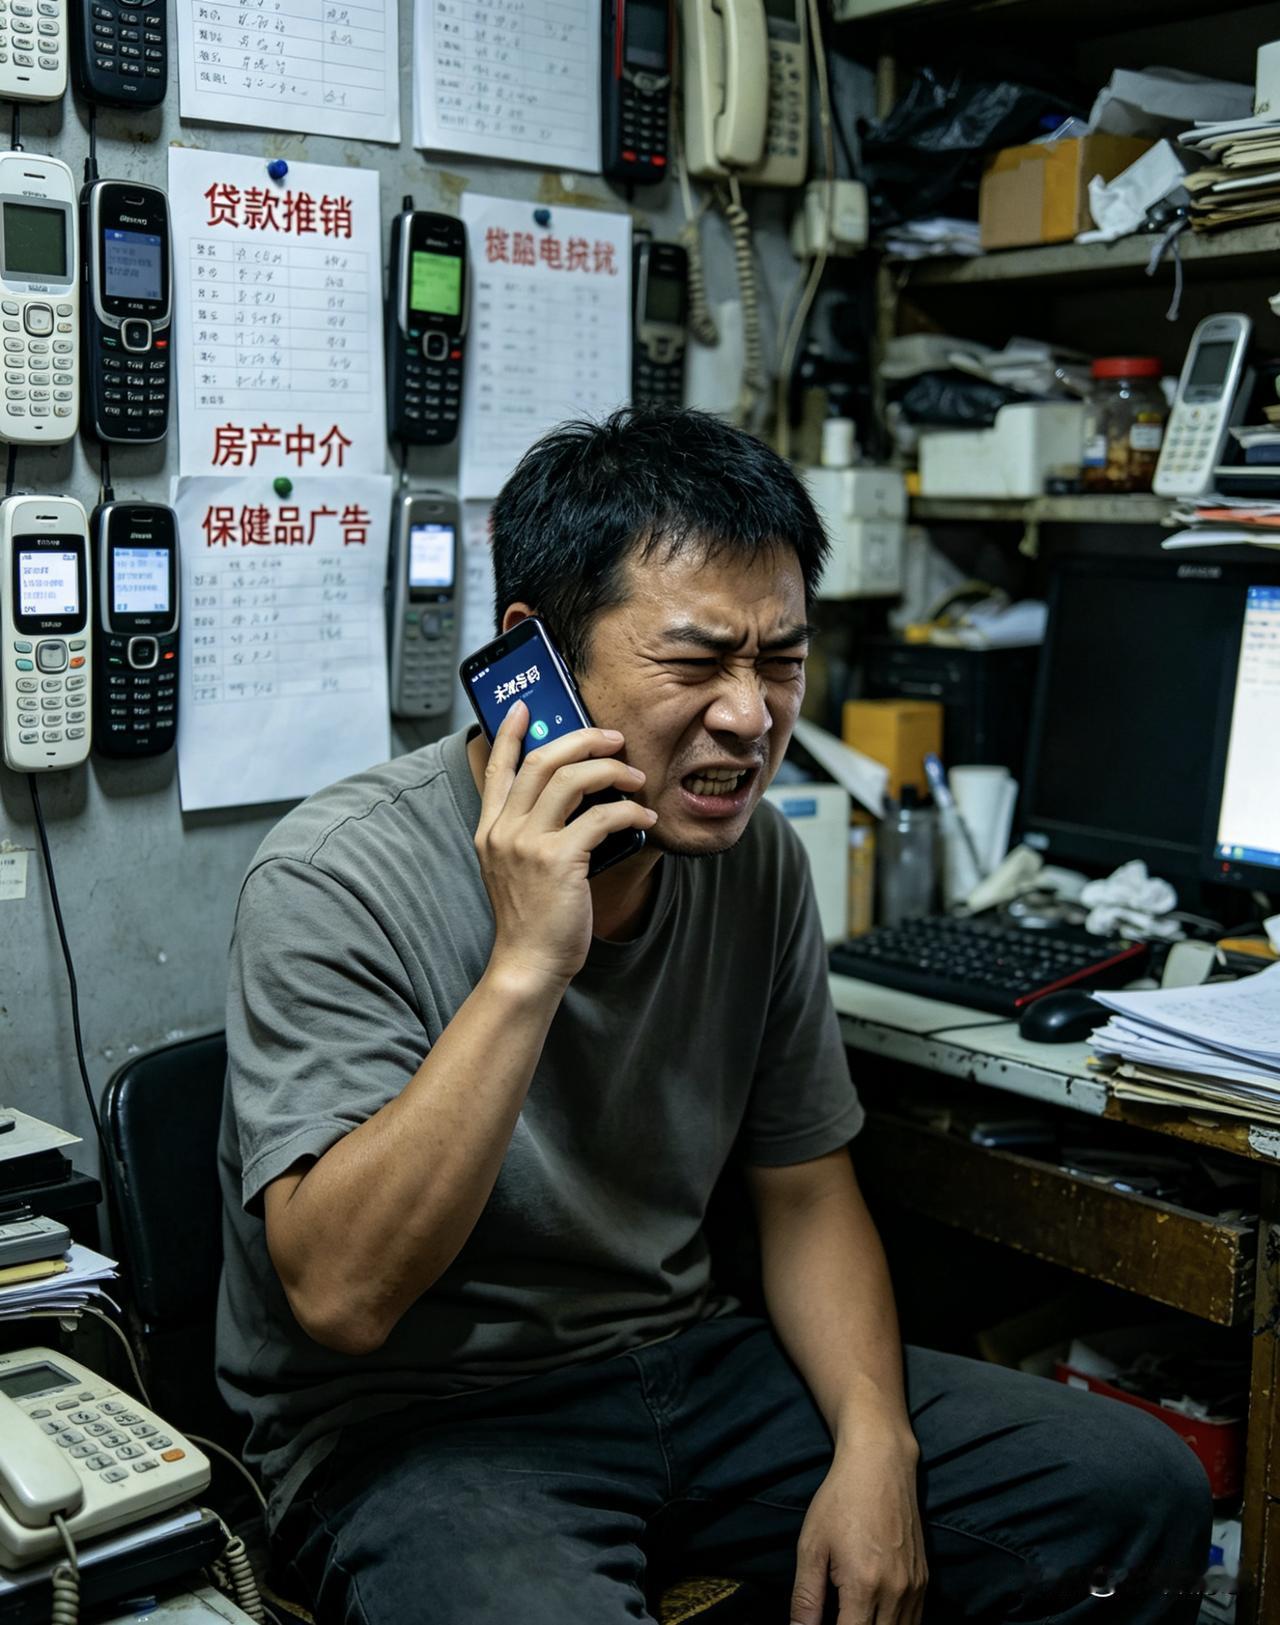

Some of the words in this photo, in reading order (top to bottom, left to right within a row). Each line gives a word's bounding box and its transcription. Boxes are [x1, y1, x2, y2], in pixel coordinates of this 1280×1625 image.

[204, 182, 354, 239] 贷款推销
[211, 422, 353, 468] 房产中介
[201, 504, 372, 548] 保健品广告
